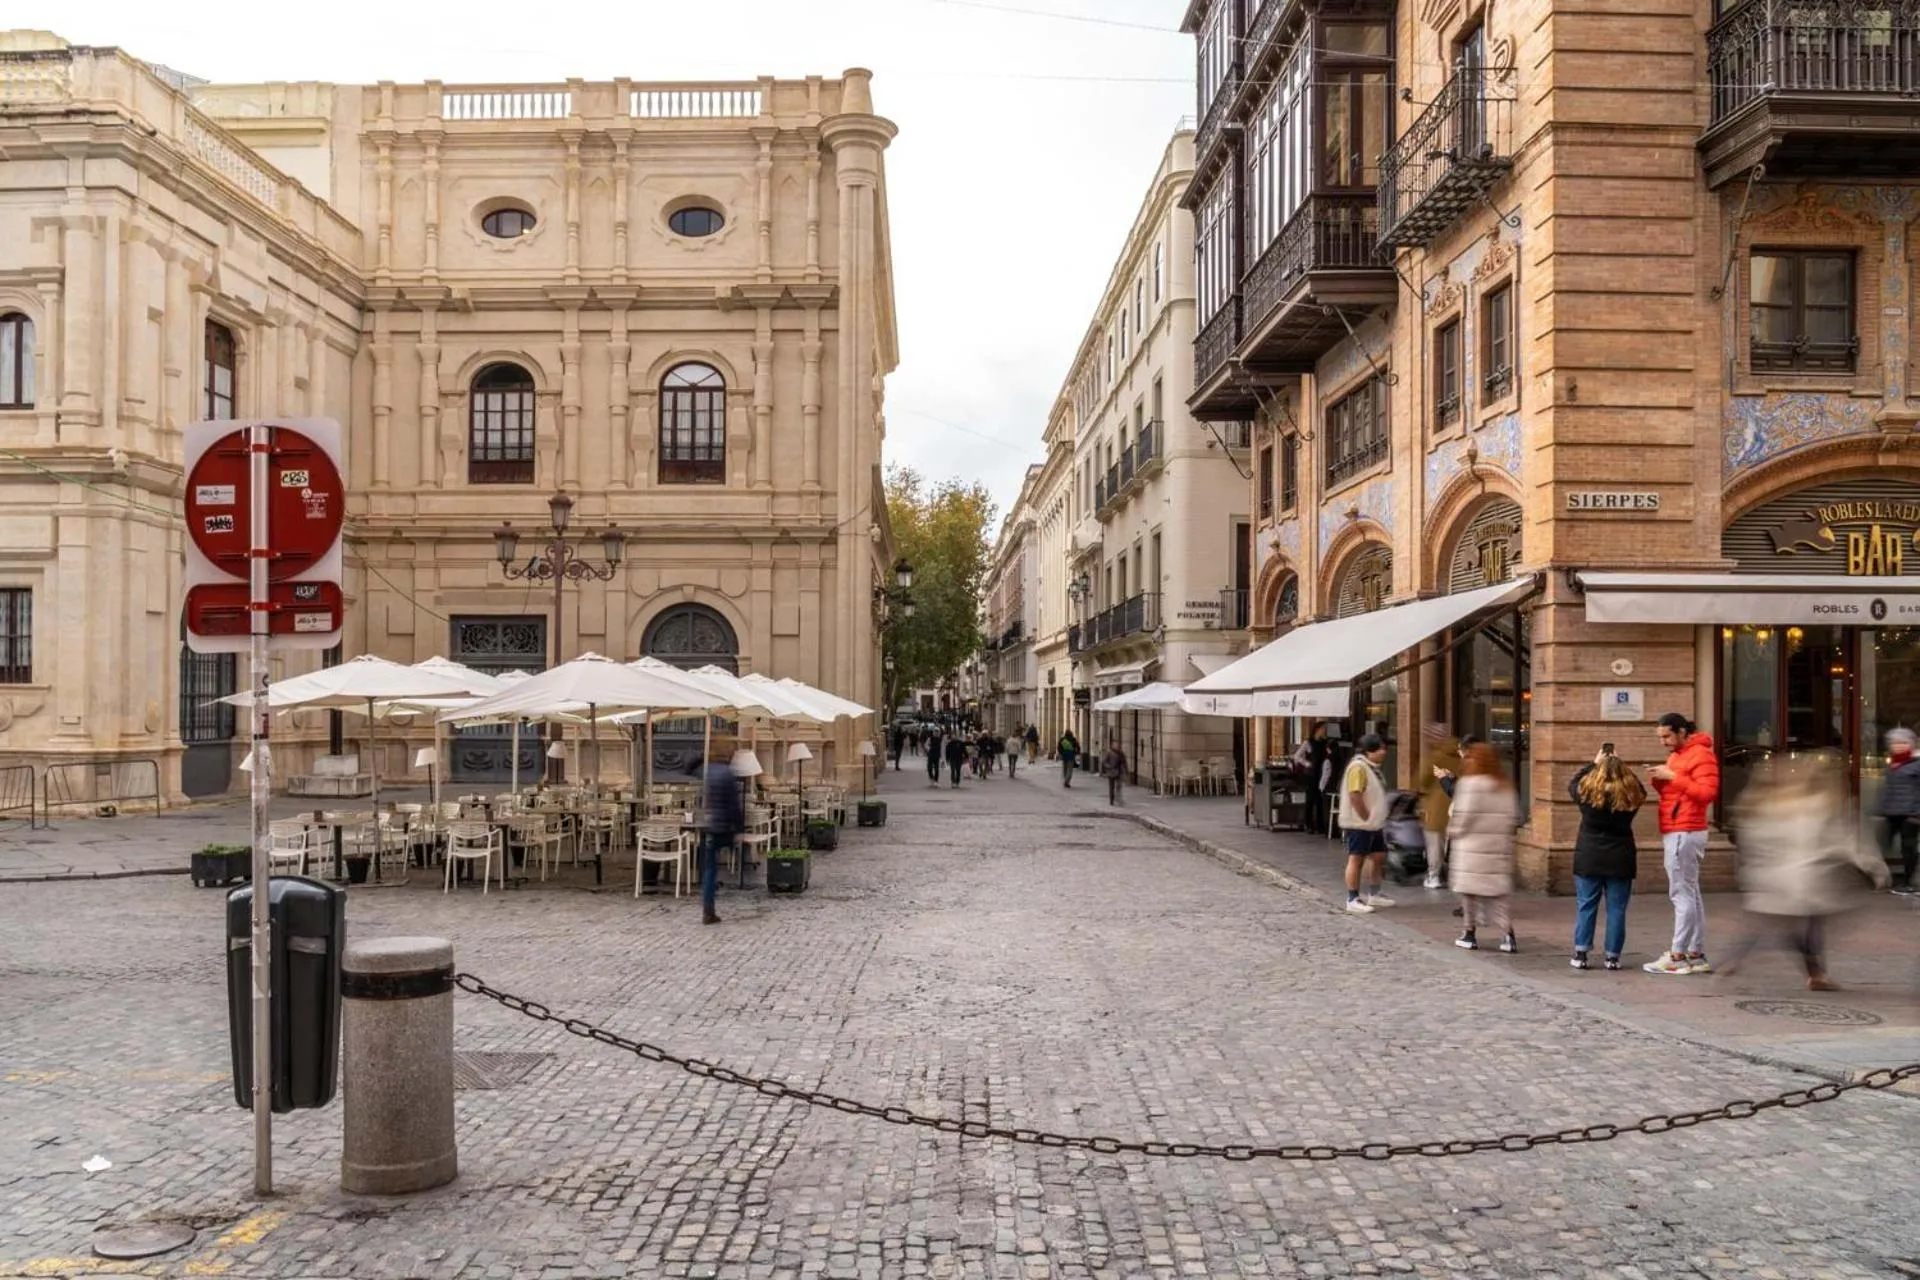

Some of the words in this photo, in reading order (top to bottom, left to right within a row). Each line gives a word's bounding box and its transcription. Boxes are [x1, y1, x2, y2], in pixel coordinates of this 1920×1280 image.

[1568, 494, 1658, 508] SIERPES
[1819, 501, 1873, 523] ROBLES
[1848, 524, 1902, 575] BAR
[1813, 605, 1859, 613] ROBLES
[1899, 605, 1920, 613] BAR
